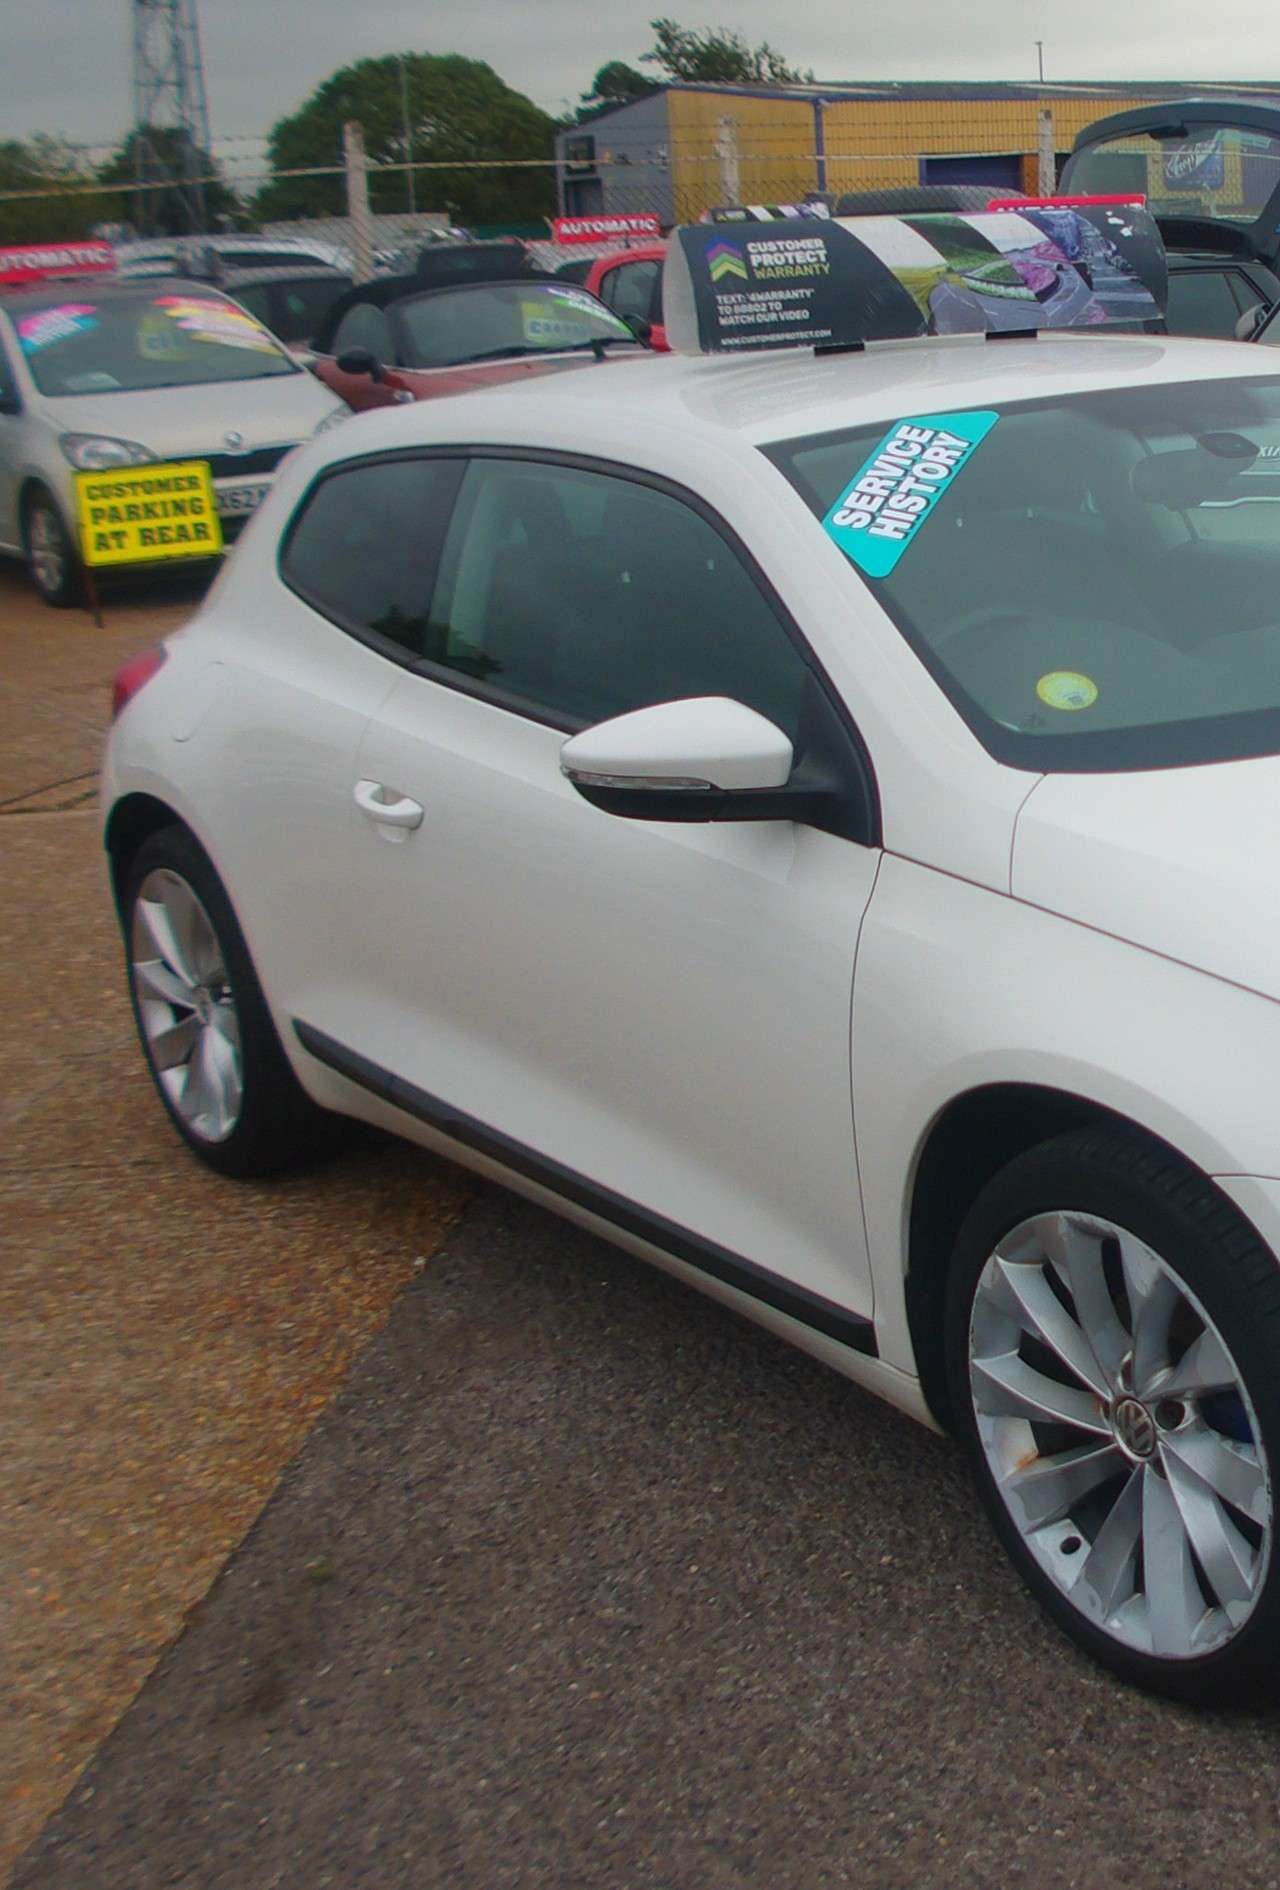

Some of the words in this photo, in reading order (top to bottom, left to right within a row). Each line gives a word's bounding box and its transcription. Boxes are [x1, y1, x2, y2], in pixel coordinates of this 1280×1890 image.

[559, 218, 657, 234] AUTOMATIC
[747, 238, 825, 253] CUSTOMER
[750, 249, 828, 267] PROTECT
[753, 263, 831, 280] WARRANTY
[717, 305, 732, 315] TO
[768, 301, 783, 311] TO
[718, 313, 755, 325] WATCH
[756, 312, 778, 323] OUR
[778, 308, 810, 321] VIDEO
[832, 425, 935, 529] SERVICE
[868, 431, 971, 540] HISTORY
[85, 475, 200, 501] CUSTOMER
[90, 497, 205, 525] PARKING
[94, 530, 128, 551] AT
[138, 522, 210, 547] REAR
